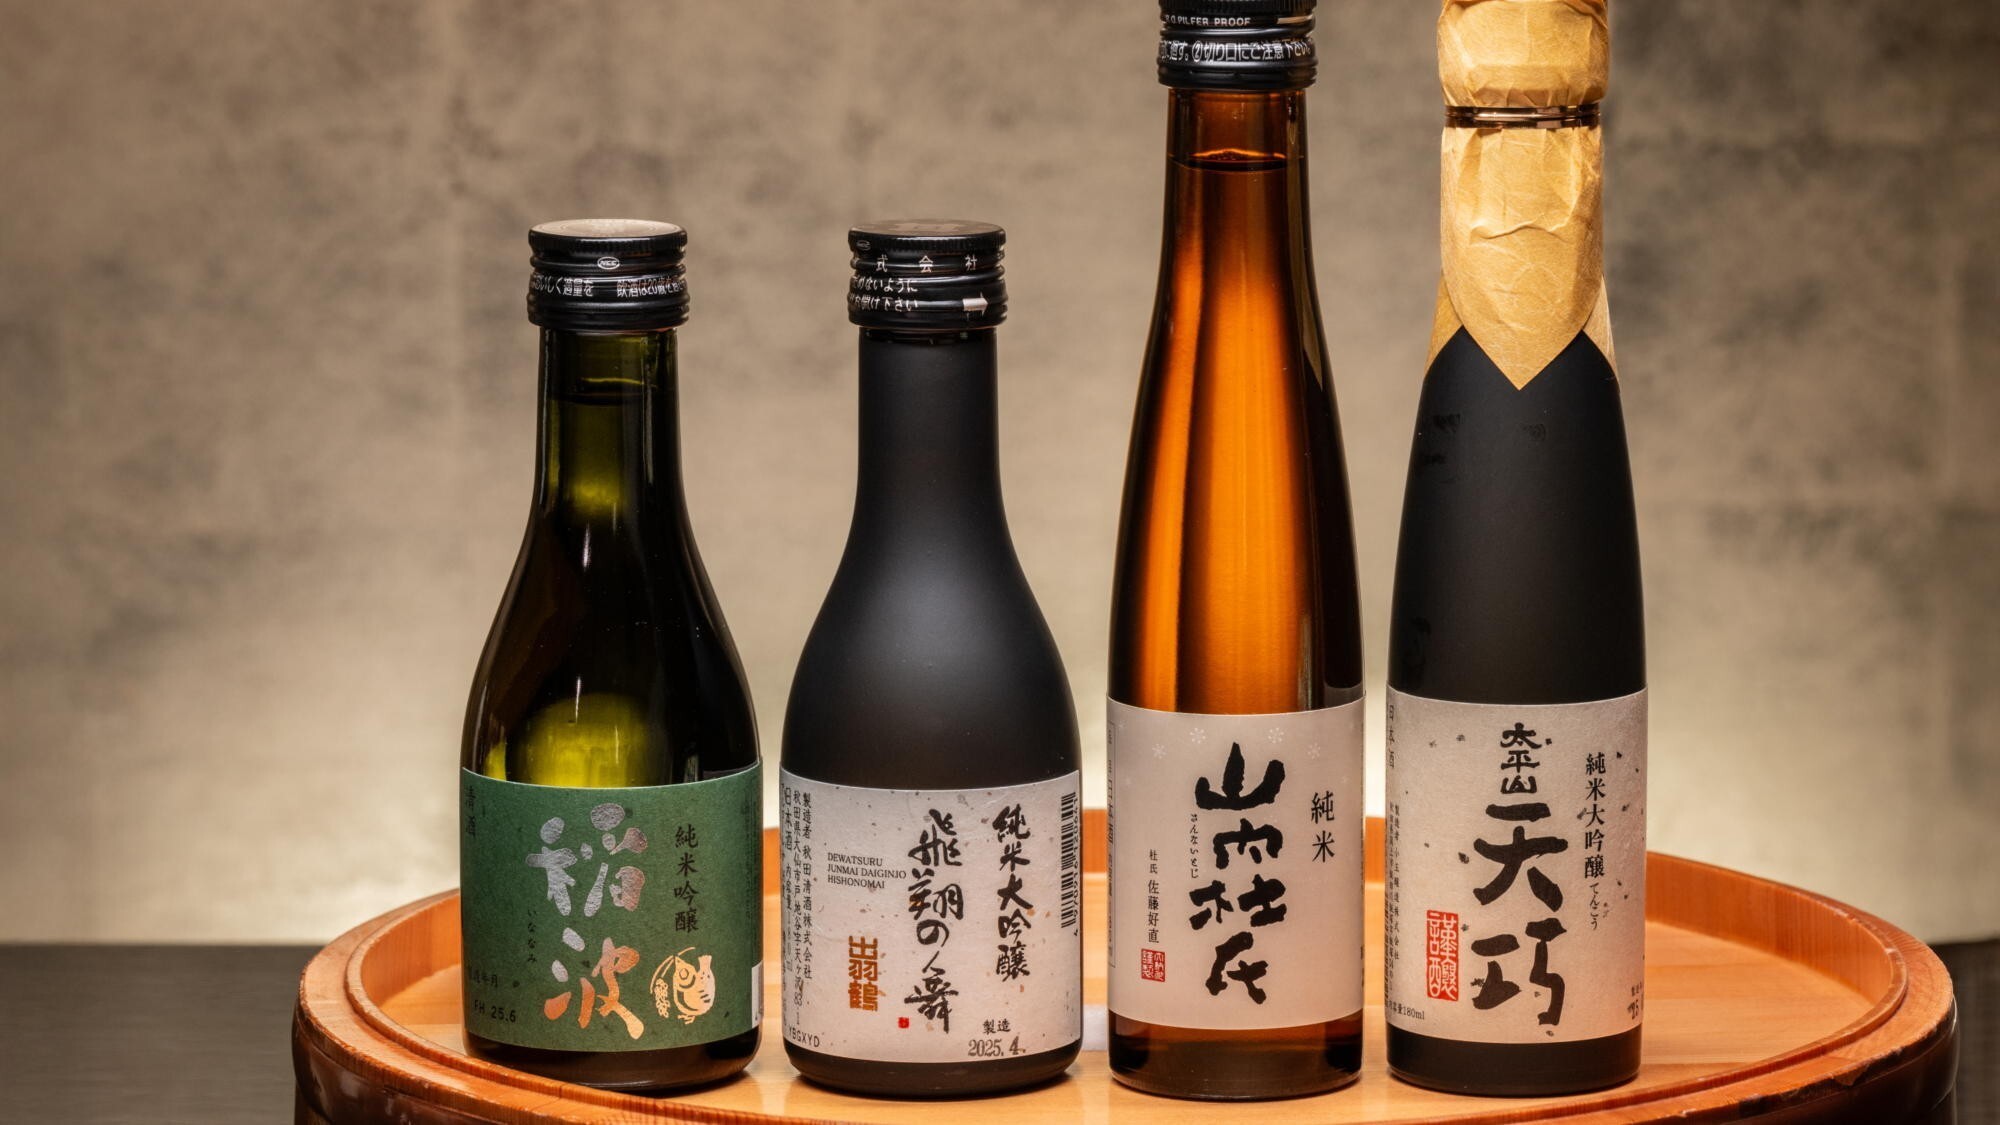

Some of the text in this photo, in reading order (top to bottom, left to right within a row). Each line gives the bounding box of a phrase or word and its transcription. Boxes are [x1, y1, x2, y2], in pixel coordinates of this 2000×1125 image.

[1214, 17, 1251, 27] PROOF
[1190, 813, 1200, 879] さんないとじ
[1310, 790, 1335, 863] 純米
[1584, 752, 1607, 879] 純米大吟醸
[674, 823, 699, 933] 純米吟醸
[827, 852, 883, 867] DEWATSURU
[827, 866, 906, 879] JUNMAI DAIGINJO
[827, 876, 885, 889] HISHONOMAI
[803, 845, 813, 980] 秋田清酒株式会社
[992, 803, 1034, 983] 純米大吟醸
[1147, 879, 1160, 944] 佐藤好直
[492, 1006, 516, 1023] 25.6
[982, 1018, 1011, 1034] 製造
